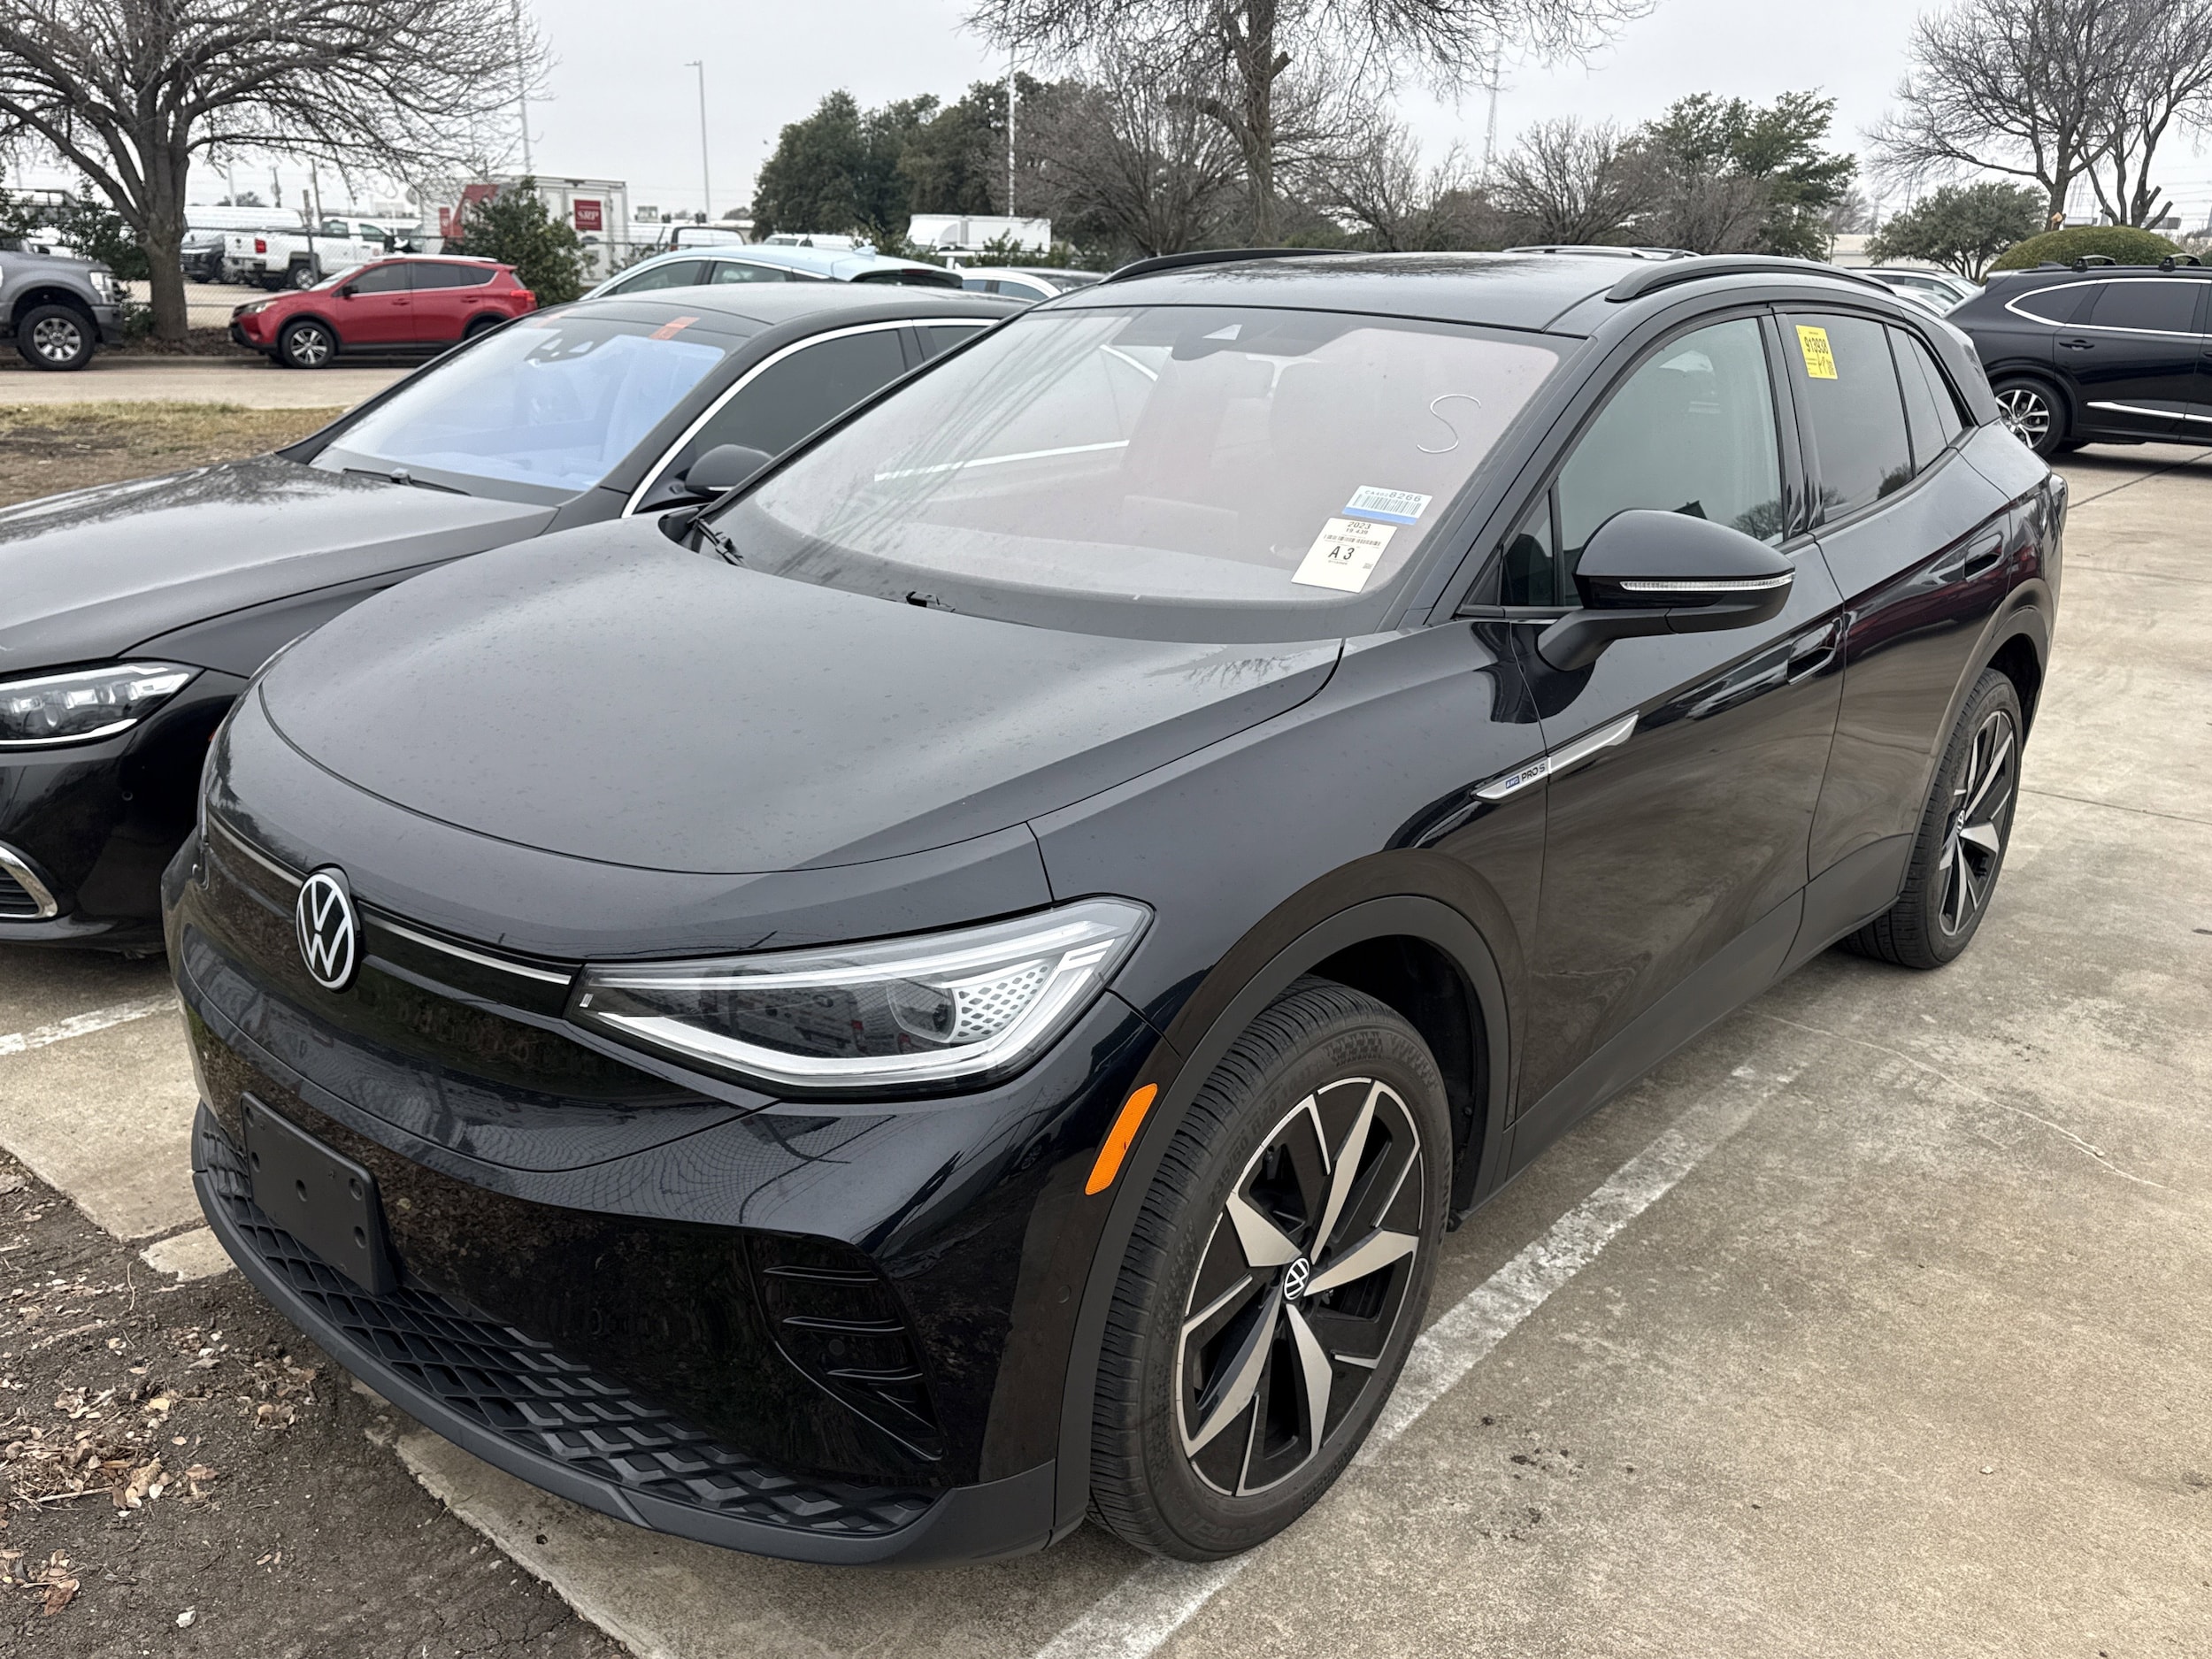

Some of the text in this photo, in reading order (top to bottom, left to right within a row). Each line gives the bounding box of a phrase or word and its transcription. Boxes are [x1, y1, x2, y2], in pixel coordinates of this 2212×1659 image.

[1416, 394, 1481, 454] S
[1521, 767, 1539, 781] PRO
[1539, 764, 1546, 772] S
